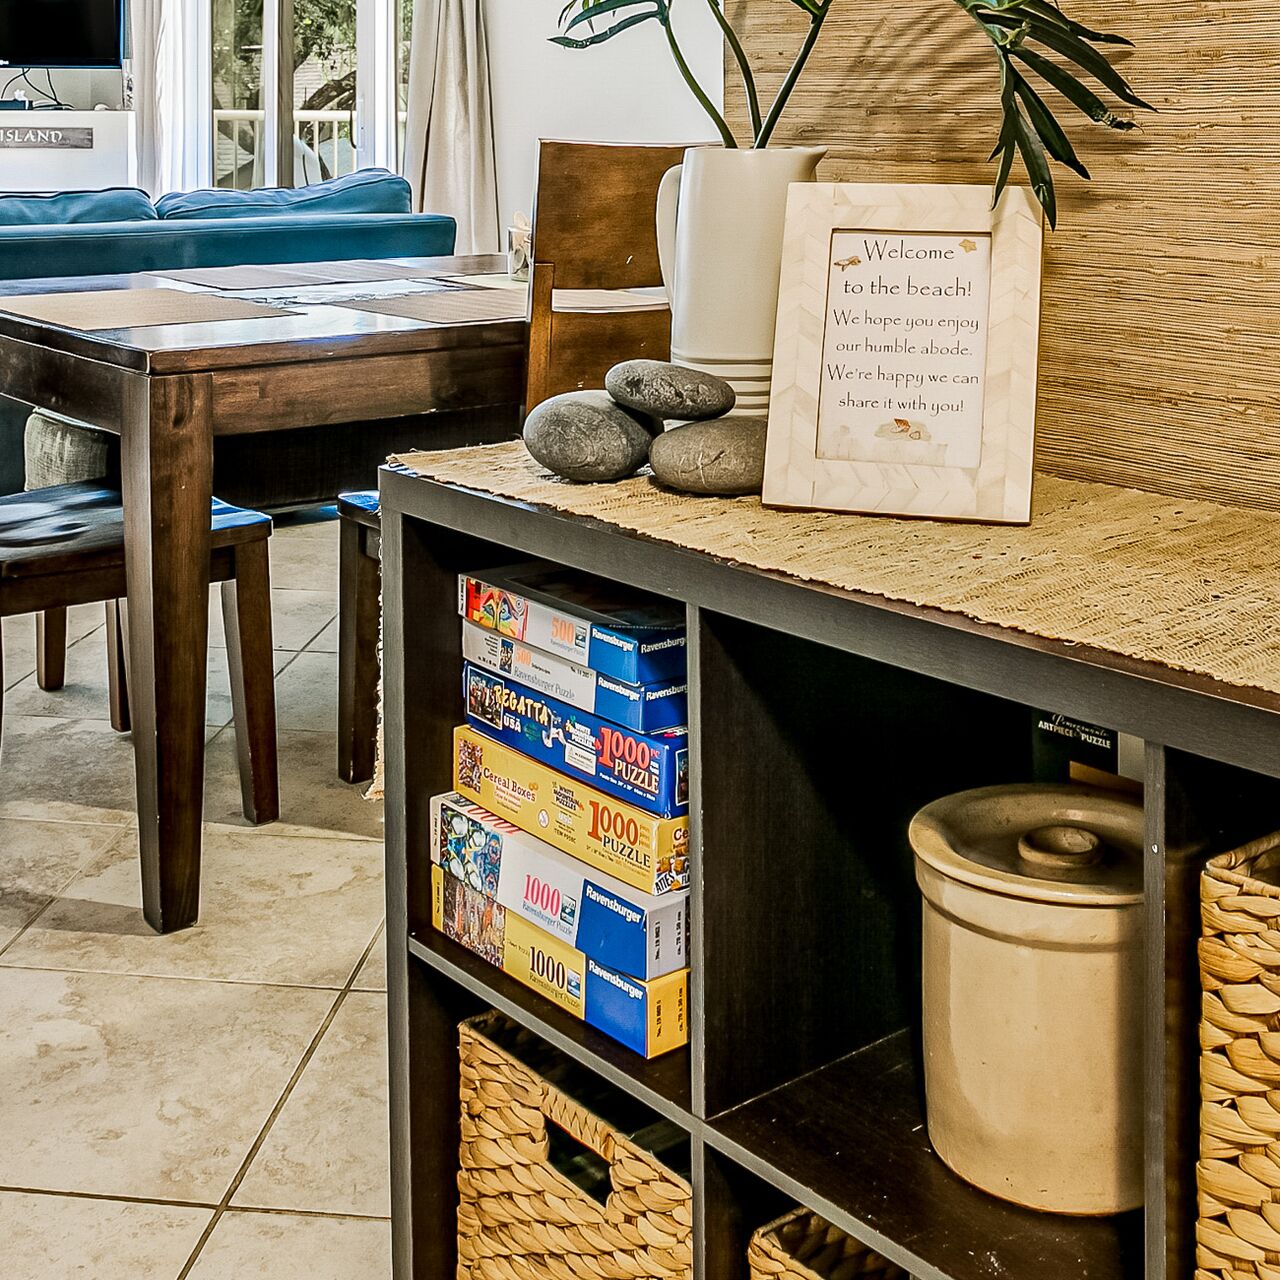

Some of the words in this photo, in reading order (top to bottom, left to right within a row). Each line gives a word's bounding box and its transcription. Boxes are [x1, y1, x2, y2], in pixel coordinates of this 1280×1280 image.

[0, 128, 63, 144] ISLAND
[863, 239, 955, 261] Welcome
[844, 279, 863, 295] to
[869, 275, 900, 296] the
[907, 276, 972, 297] beach!
[833, 309, 860, 326] We
[864, 309, 901, 332] hope
[905, 317, 934, 334] you
[937, 317, 979, 337] enjoy
[836, 342, 862, 352] our
[864, 337, 916, 355] humble
[920, 340, 972, 356] abode.
[827, 363, 873, 381] We're
[876, 365, 924, 389] happy
[928, 374, 948, 383] we
[952, 374, 979, 385] can
[838, 392, 879, 409] share
[883, 397, 893, 409] it
[897, 395, 927, 411] with
[930, 399, 964, 416] you!
[551, 617, 575, 645] 500
[591, 627, 635, 652] Ravensburger
[598, 676, 641, 701] Ravensburger
[493, 685, 550, 726] REGATTA
[503, 715, 522, 733] USA
[598, 727, 651, 770] 1000
[1081, 732, 1111, 749] PUZZLE
[483, 767, 510, 789] Cereal
[512, 782, 536, 802] Boxes
[614, 758, 660, 795] PUZZLE
[587, 799, 639, 847] 1000
[603, 834, 651, 869] PUZZLE
[523, 874, 560, 917] 1000
[586, 885, 642, 924] Ravensburger
[529, 945, 566, 990] 1000
[588, 960, 644, 1000] Ravensburger
